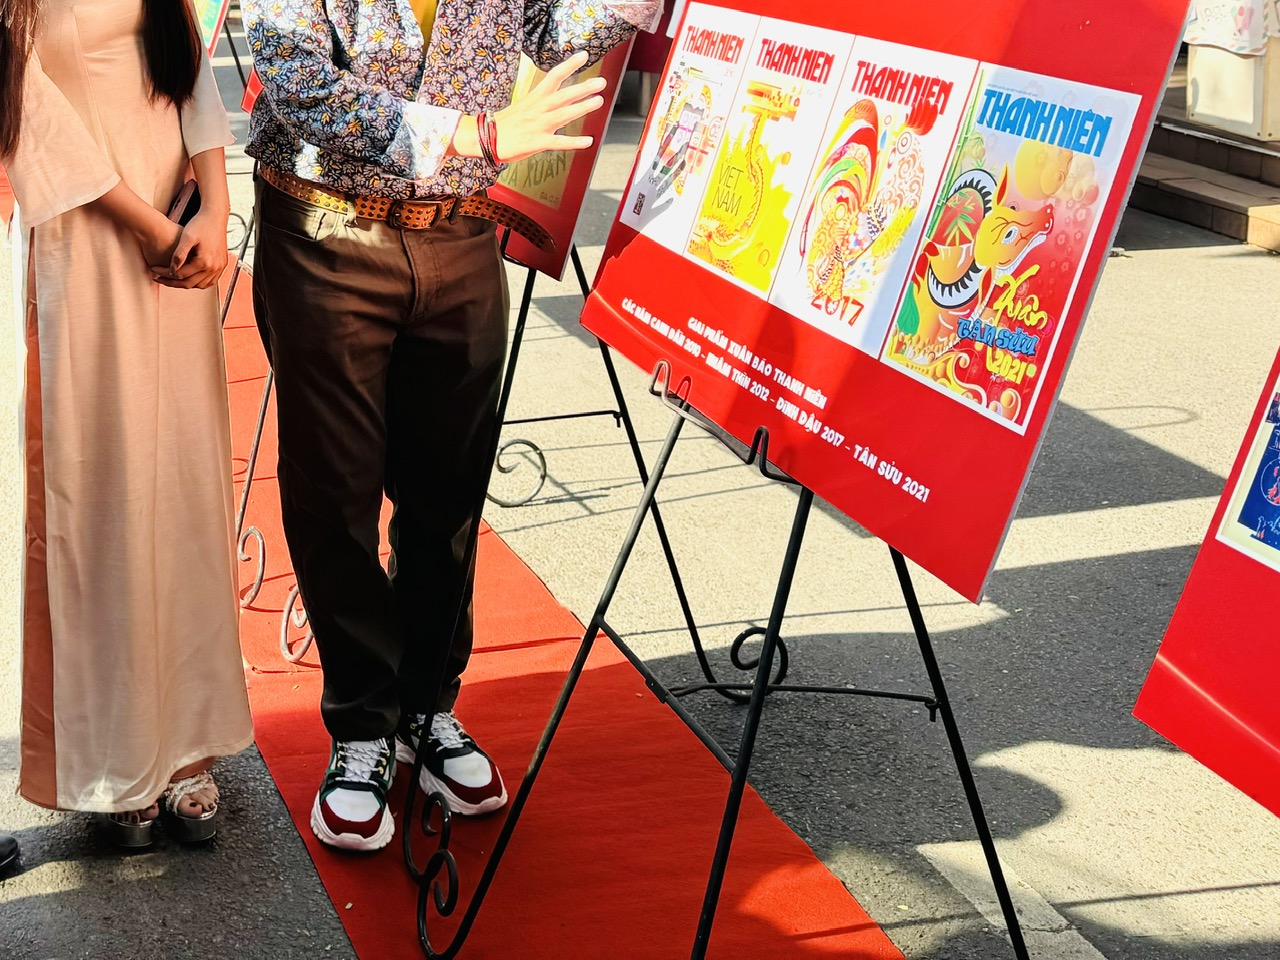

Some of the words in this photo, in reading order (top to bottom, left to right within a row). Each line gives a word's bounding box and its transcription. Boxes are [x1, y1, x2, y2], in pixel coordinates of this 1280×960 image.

[682, 25, 720, 59] THANH
[756, 38, 801, 76] THANH
[851, 60, 911, 107] THANH
[976, 88, 1057, 143] THANH
[1049, 106, 1113, 158] NIÊN
[712, 187, 742, 216] NAM
[727, 343, 753, 366] XUÂN
[751, 357, 772, 377] BÁO
[773, 367, 805, 397] THANH
[992, 350, 1028, 385] 2021
[749, 380, 771, 402] 2012
[821, 425, 845, 448] 2017
[853, 443, 878, 470] TÂN
[878, 460, 903, 486] SỬU
[901, 476, 931, 503] 2021
